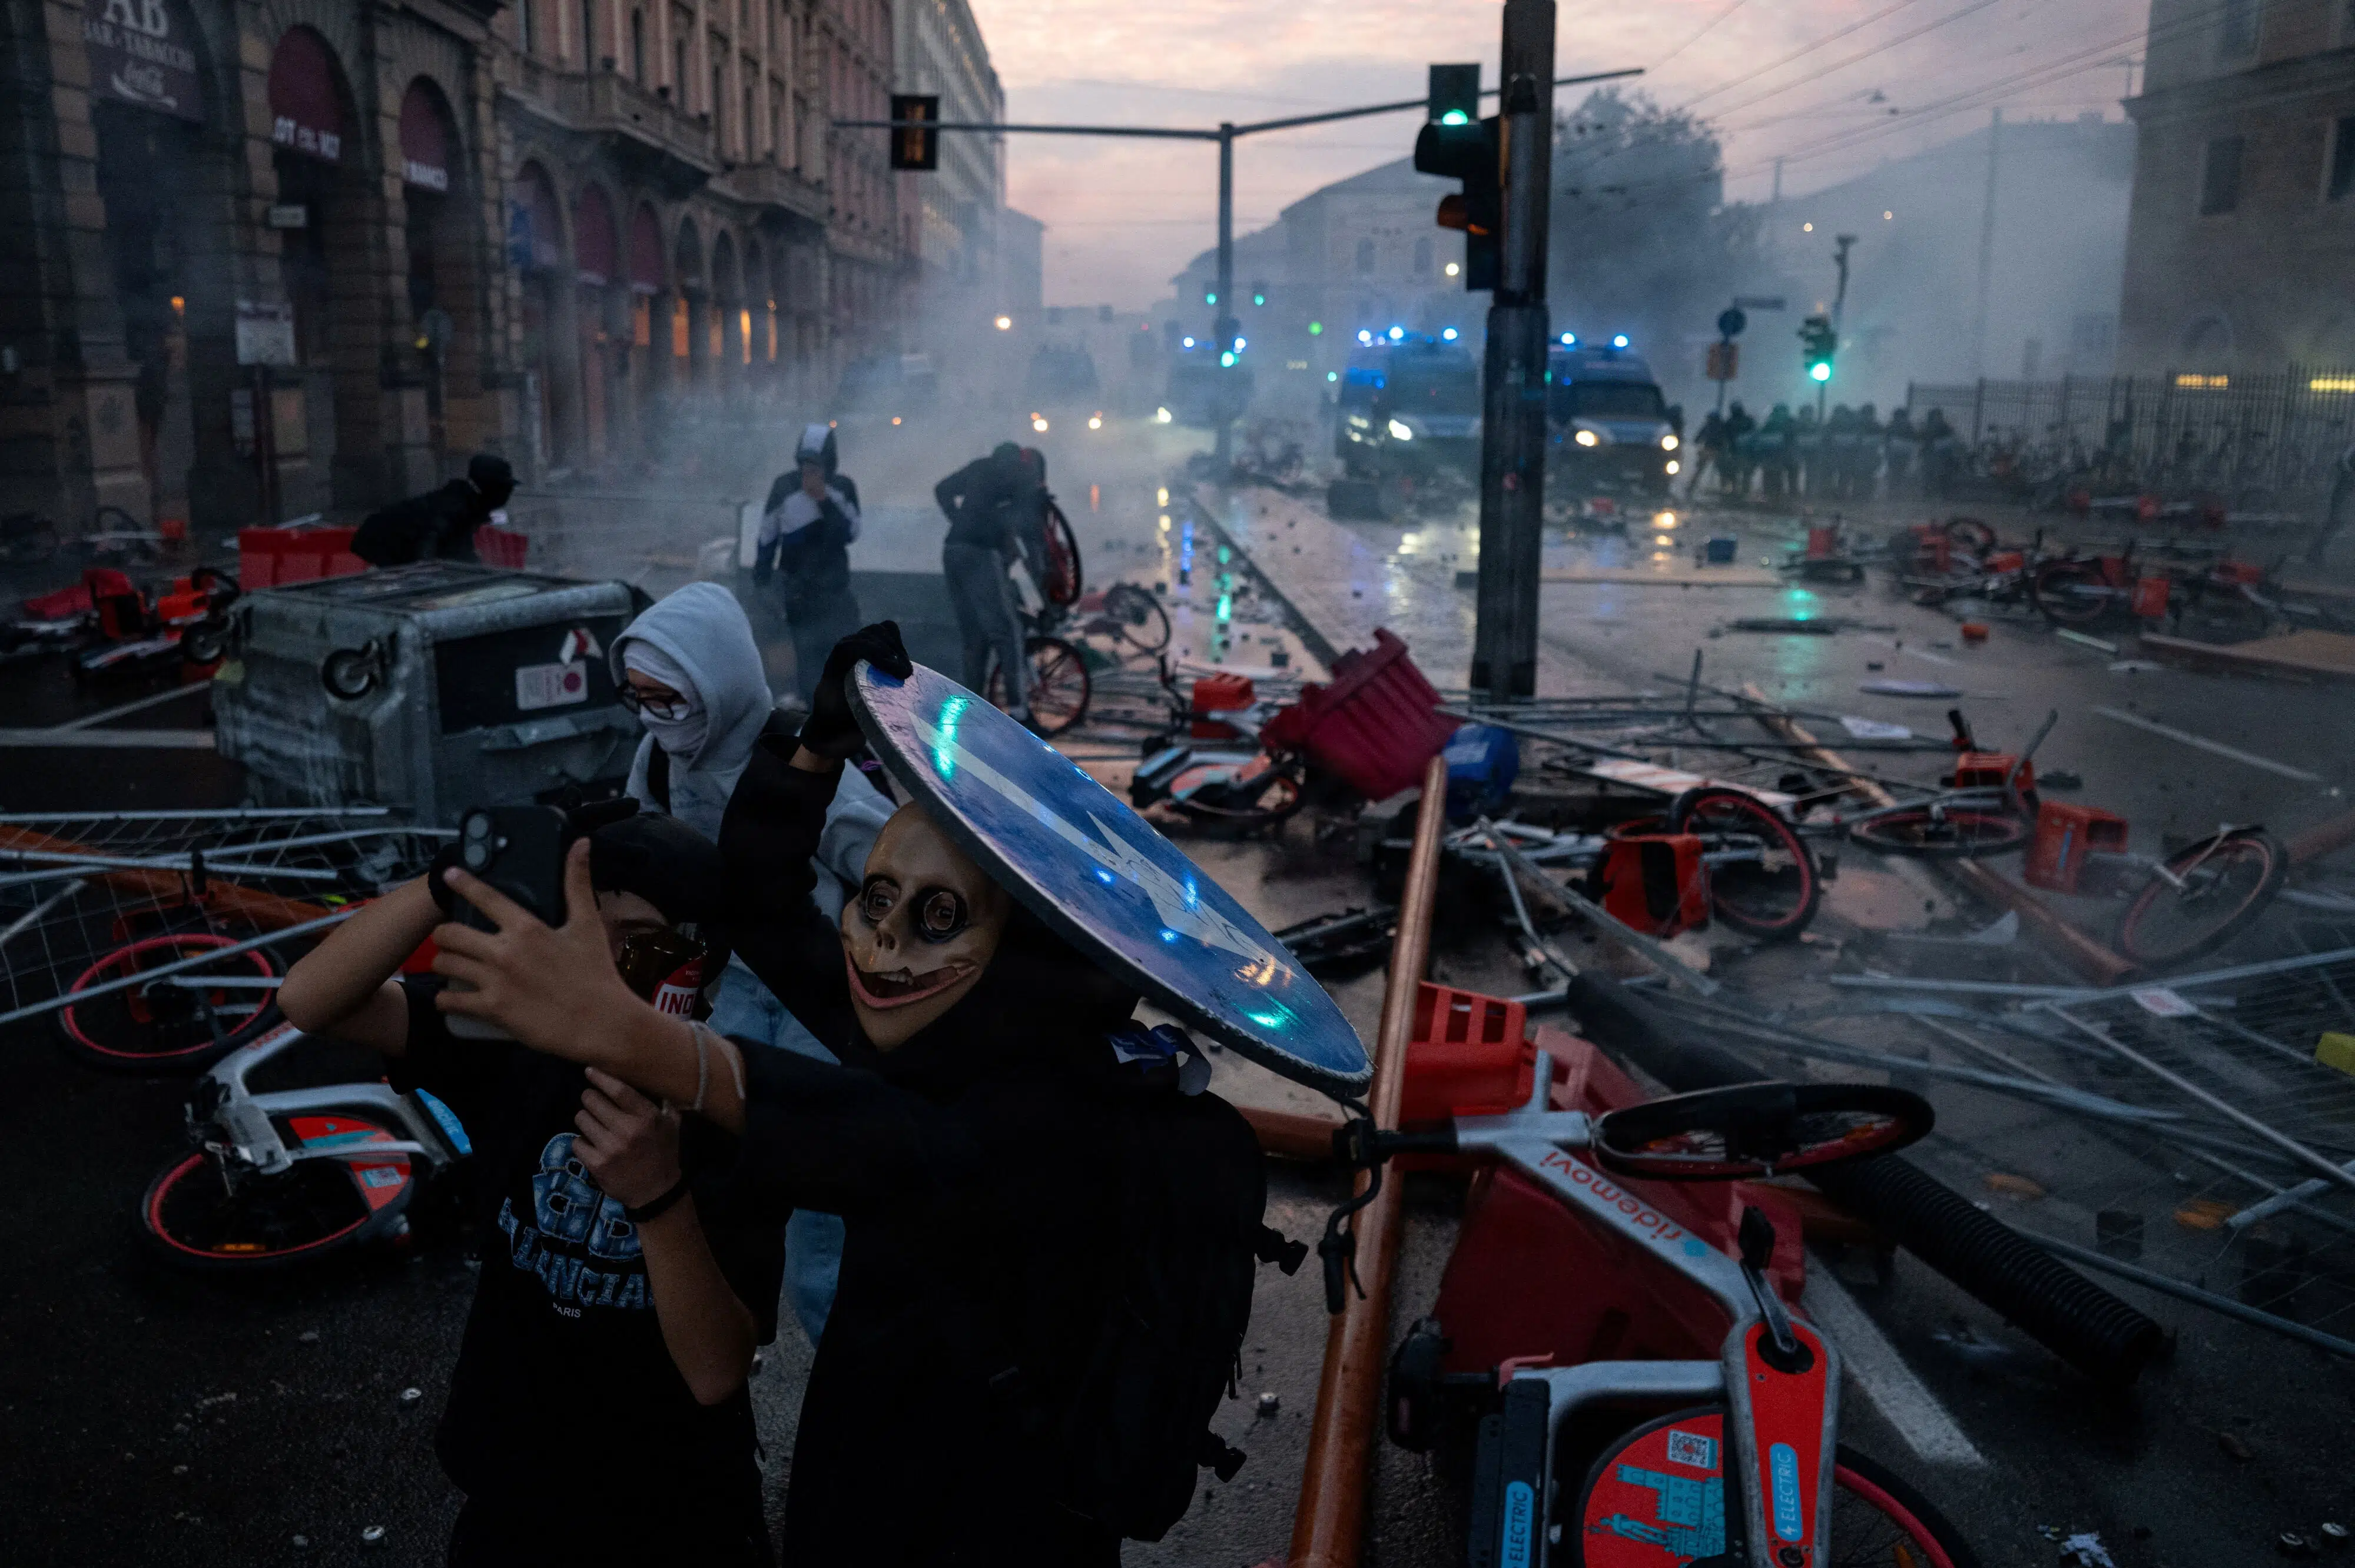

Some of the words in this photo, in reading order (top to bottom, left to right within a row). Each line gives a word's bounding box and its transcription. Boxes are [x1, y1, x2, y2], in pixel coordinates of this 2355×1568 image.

[1539, 1151, 1682, 1240] ridemovi
[553, 1301, 582, 1318] PARIS
[1777, 1452, 1795, 1521] ELECTRIC
[1508, 1491, 1528, 1561] ELECTRIC
